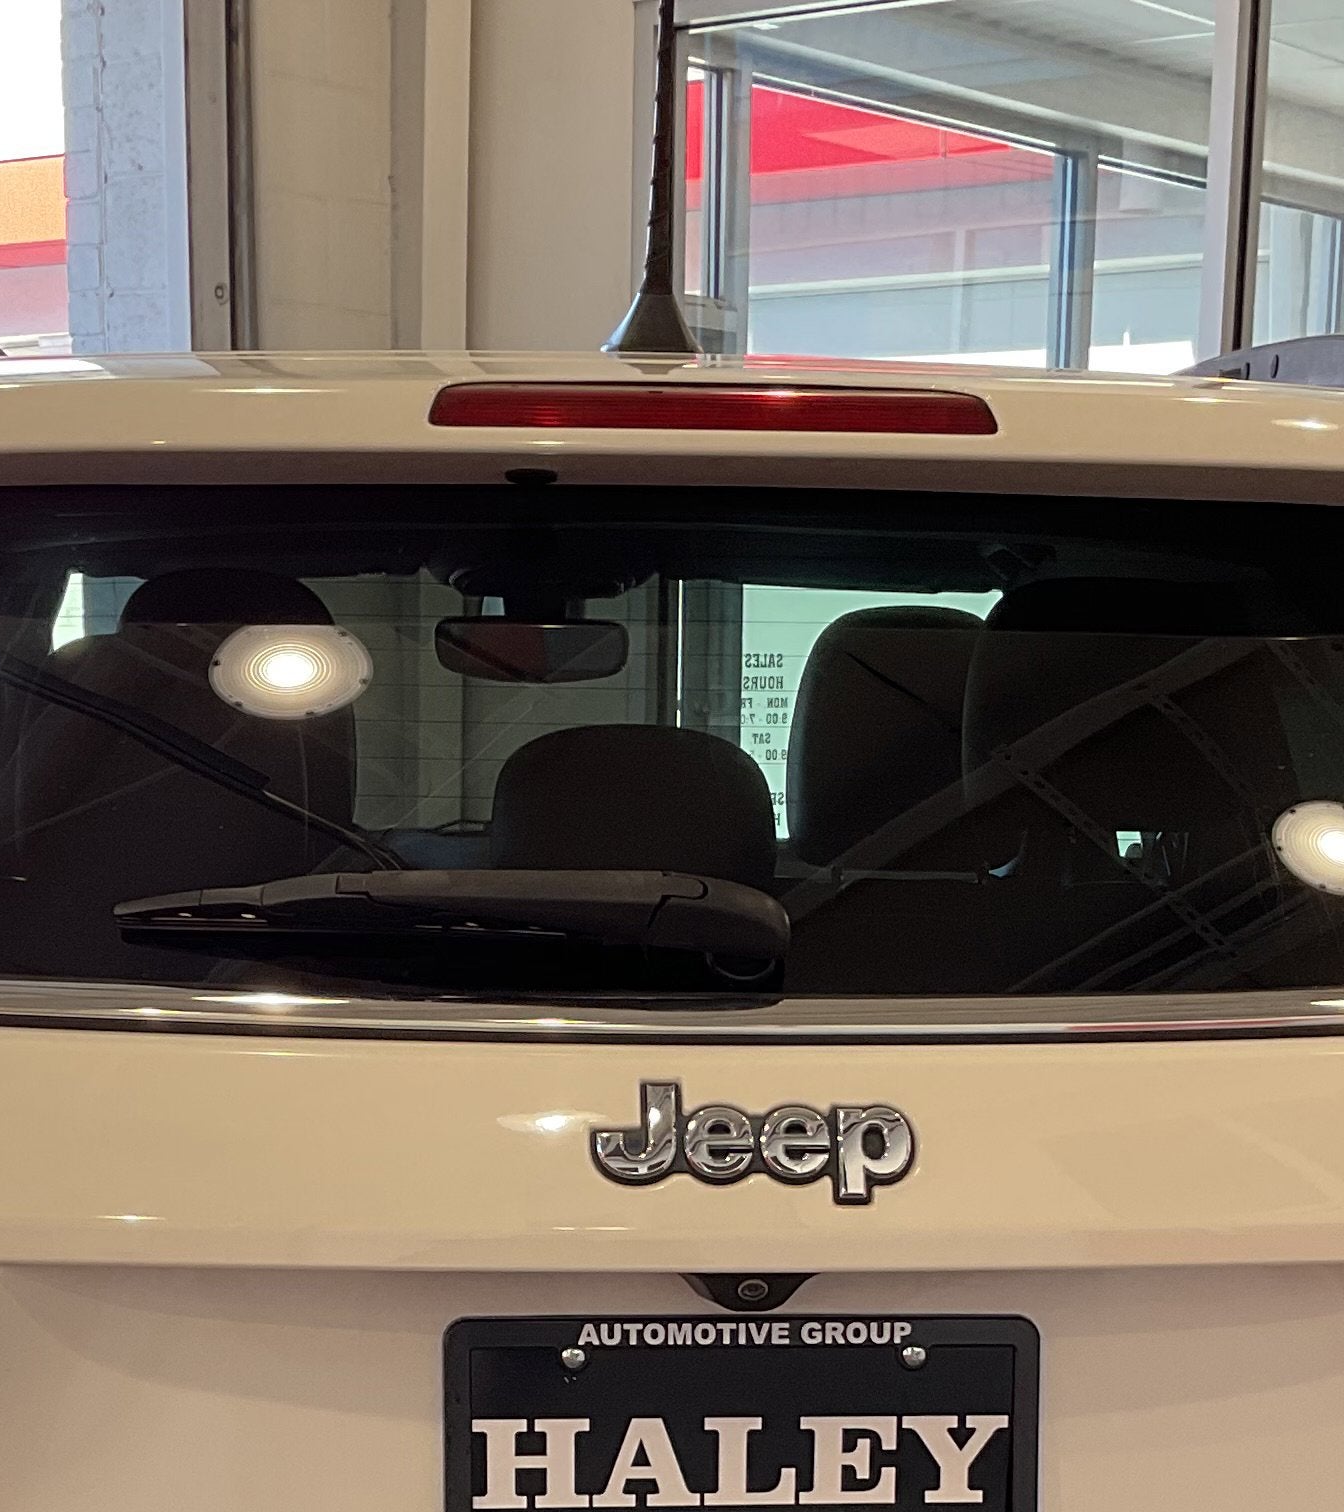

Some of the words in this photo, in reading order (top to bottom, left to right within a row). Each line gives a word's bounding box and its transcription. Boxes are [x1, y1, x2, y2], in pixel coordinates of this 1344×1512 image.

[590, 1079, 916, 1206] Jeep
[578, 1322, 790, 1346] AUTOMOTIVE
[800, 1321, 912, 1345] GROUP
[471, 1414, 1009, 1510] HALEY
